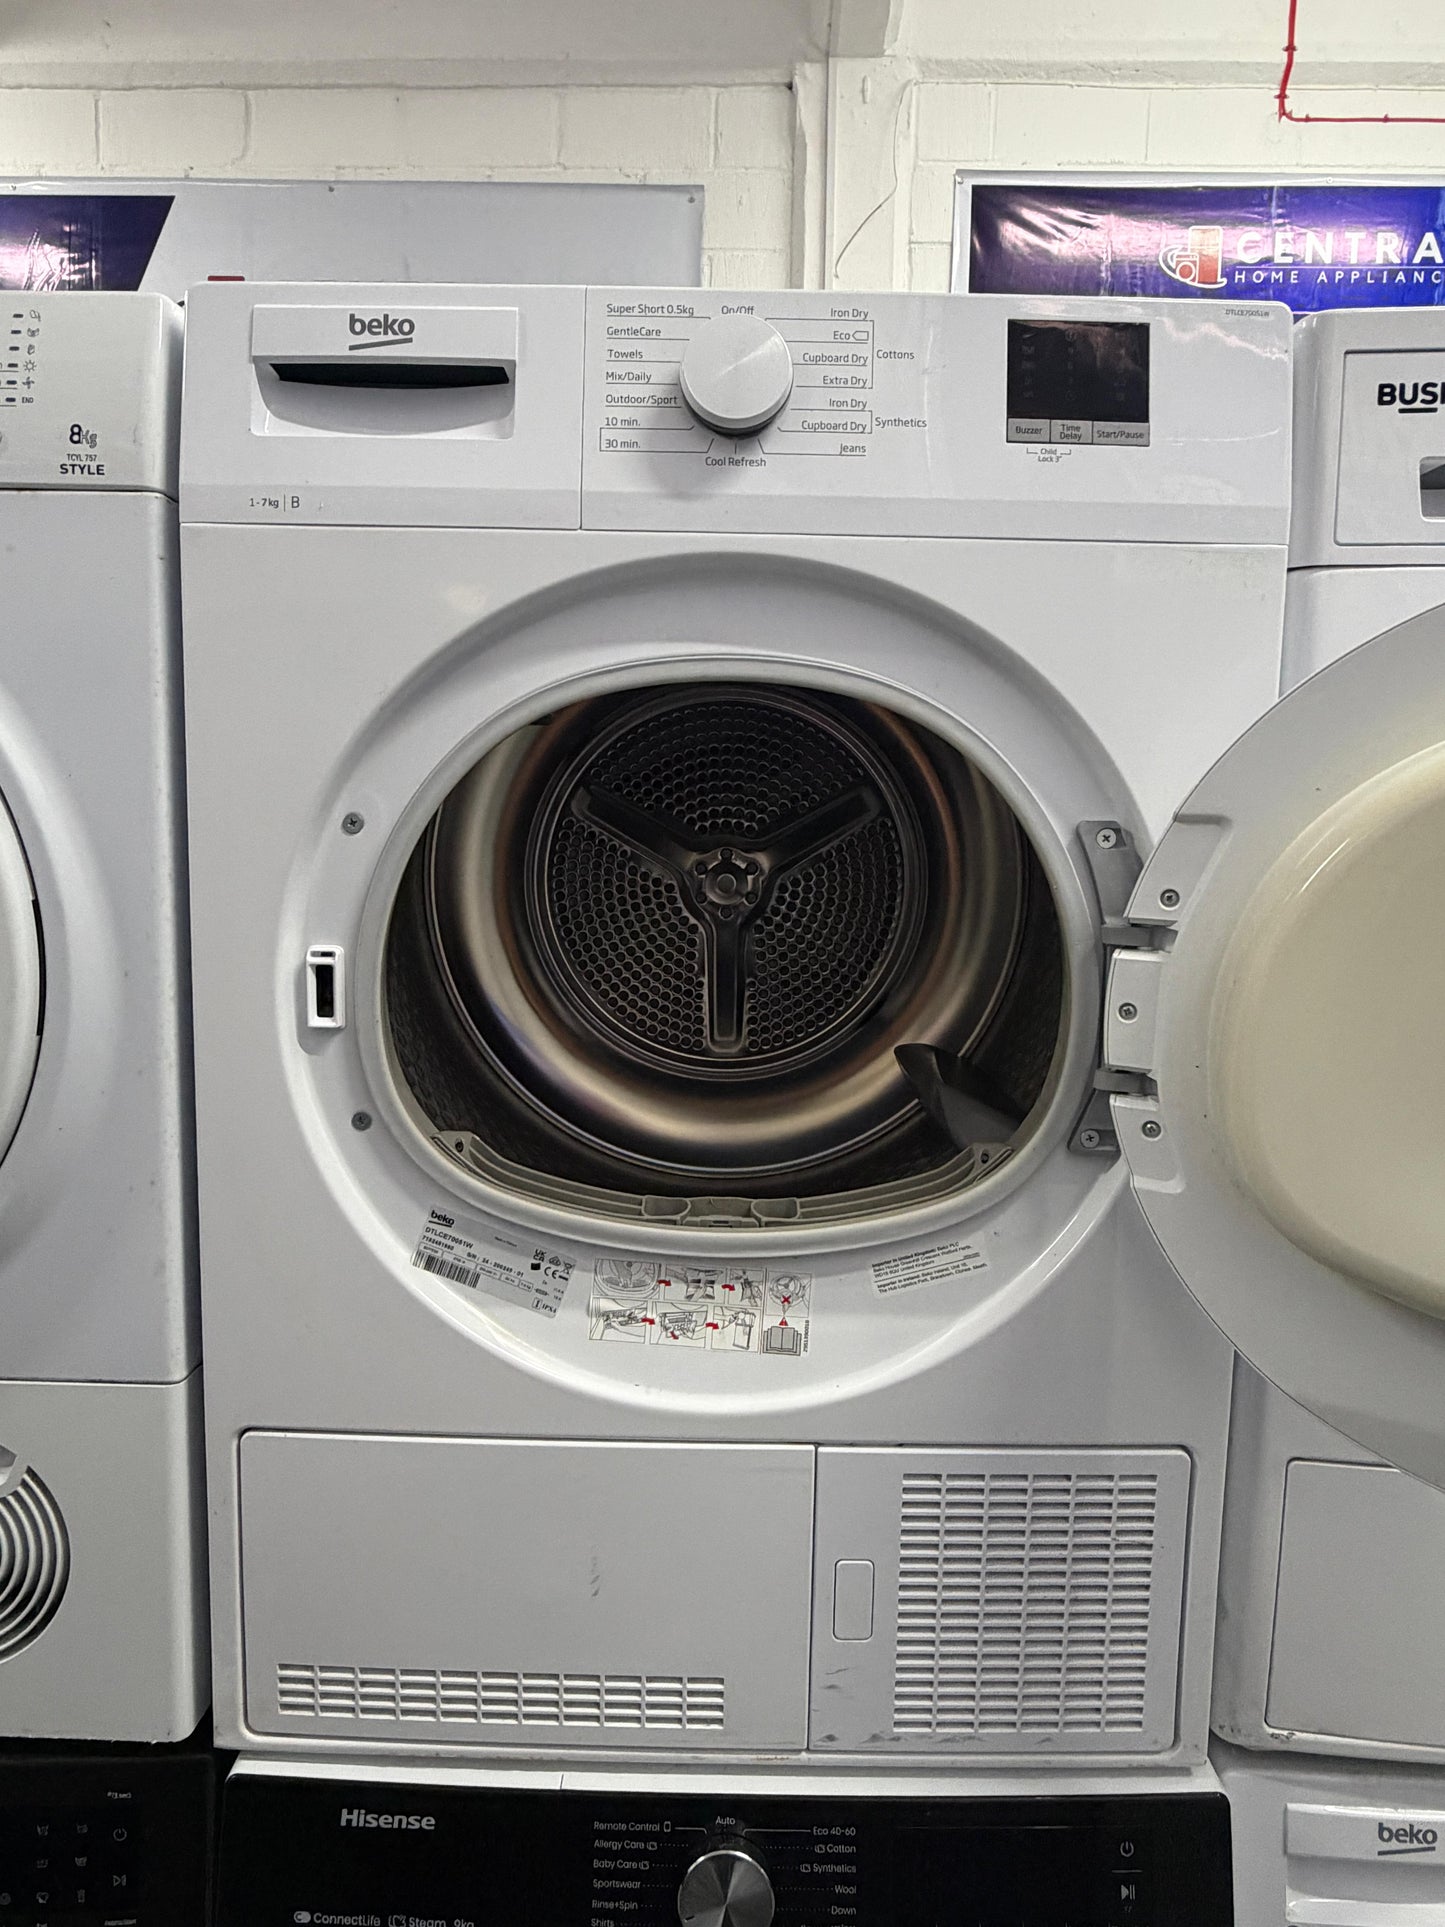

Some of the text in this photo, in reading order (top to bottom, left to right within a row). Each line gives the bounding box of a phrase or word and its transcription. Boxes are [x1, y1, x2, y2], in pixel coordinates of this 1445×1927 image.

[1237, 232, 1443, 263] CENTRA
[1235, 271, 1441, 283] HOME APPLIANC
[607, 304, 694, 317] Super Short 0.5kg
[721, 306, 754, 315] On/Off
[830, 308, 869, 320] Iron Dry
[349, 313, 415, 335] beko
[607, 327, 661, 337] GentleCare
[833, 331, 850, 341] Eco
[607, 349, 643, 359] Towels
[803, 353, 868, 365] Cupboard Dry
[876, 350, 915, 360] Cottons
[606, 372, 652, 383] Mix/Daily
[823, 376, 867, 387] Extra Dry
[1377, 382, 1445, 405] BUS
[606, 394, 677, 406] Outdoor/Sport
[829, 399, 867, 410] Iron Dry
[605, 417, 641, 426] 10 min.
[801, 421, 867, 433] Cupboard Dry
[875, 417, 927, 429] Synthetics
[1016, 426, 1042, 434] Buzzer
[1061, 424, 1080, 432] Time
[1060, 432, 1082, 441] Delay
[1097, 430, 1144, 439] Start/Pause
[605, 439, 641, 448] 30 min.
[840, 444, 866, 455] Jeans
[705, 456, 766, 467] Cool Refresh
[60, 464, 105, 475] STYLE
[291, 496, 300, 507] B
[429, 1209, 456, 1226] beko
[340, 1808, 436, 1830] Hisense
[715, 1816, 736, 1825] Auto
[594, 1822, 660, 1831] Remote Control
[813, 1827, 856, 1836] Eco 40-60
[1377, 1822, 1438, 1846] beko
[594, 1840, 644, 1851] Allergy Care
[826, 1844, 856, 1853] Cotton
[593, 1859, 637, 1870] Baby Care
[813, 1864, 856, 1874] Synthetics
[593, 1880, 640, 1890] Sportswear
[835, 1885, 856, 1894] Wool
[831, 1906, 856, 1915] Down
[313, 1913, 381, 1927] ConnectLife
[591, 1918, 615, 1927] Shirts
